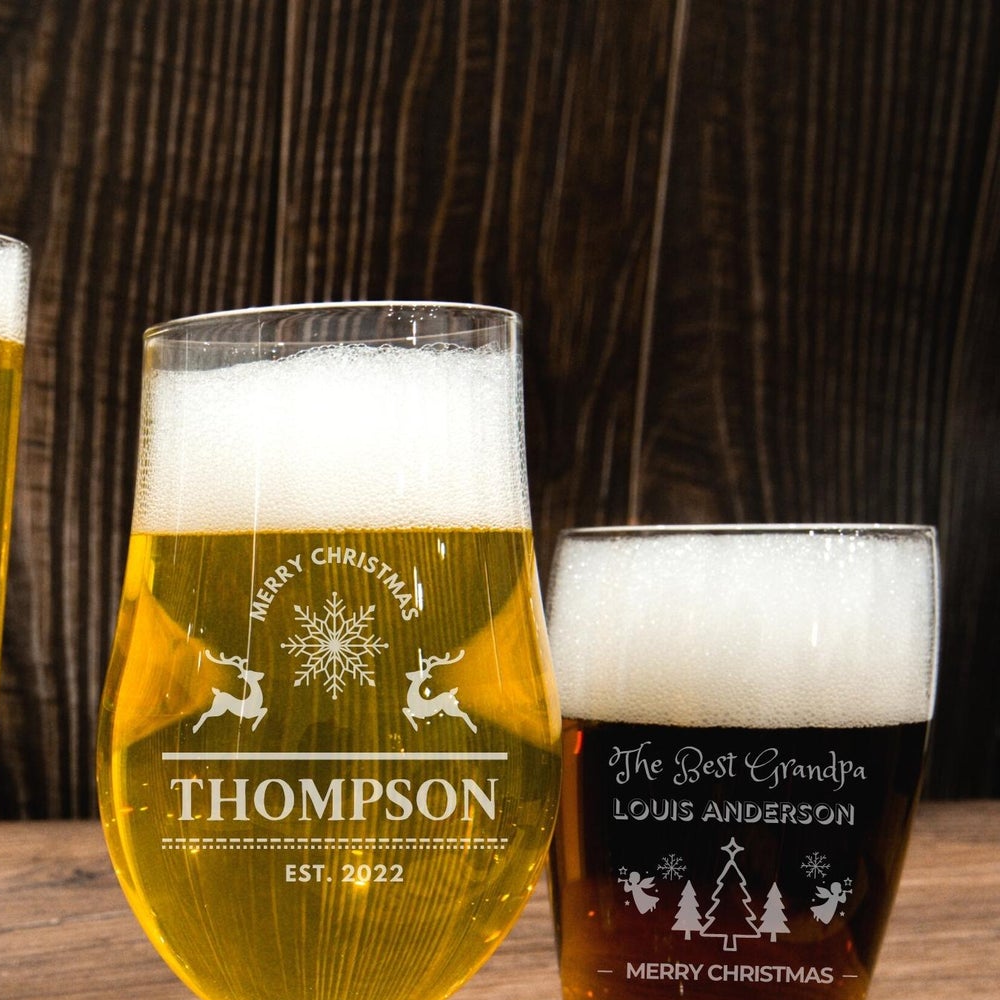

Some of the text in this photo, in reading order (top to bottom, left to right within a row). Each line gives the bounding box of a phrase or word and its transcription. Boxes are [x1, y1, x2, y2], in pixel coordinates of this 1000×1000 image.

[249, 546, 419, 622] MERRY CHRISTMAS
[608, 741, 867, 792] The Best Grandpa
[170, 778, 499, 821] THOMPSON
[612, 798, 855, 825] LOUIS ANDERSON
[285, 864, 404, 883] EST. 2022
[626, 962, 834, 984] MERRY CHRISTMAS
